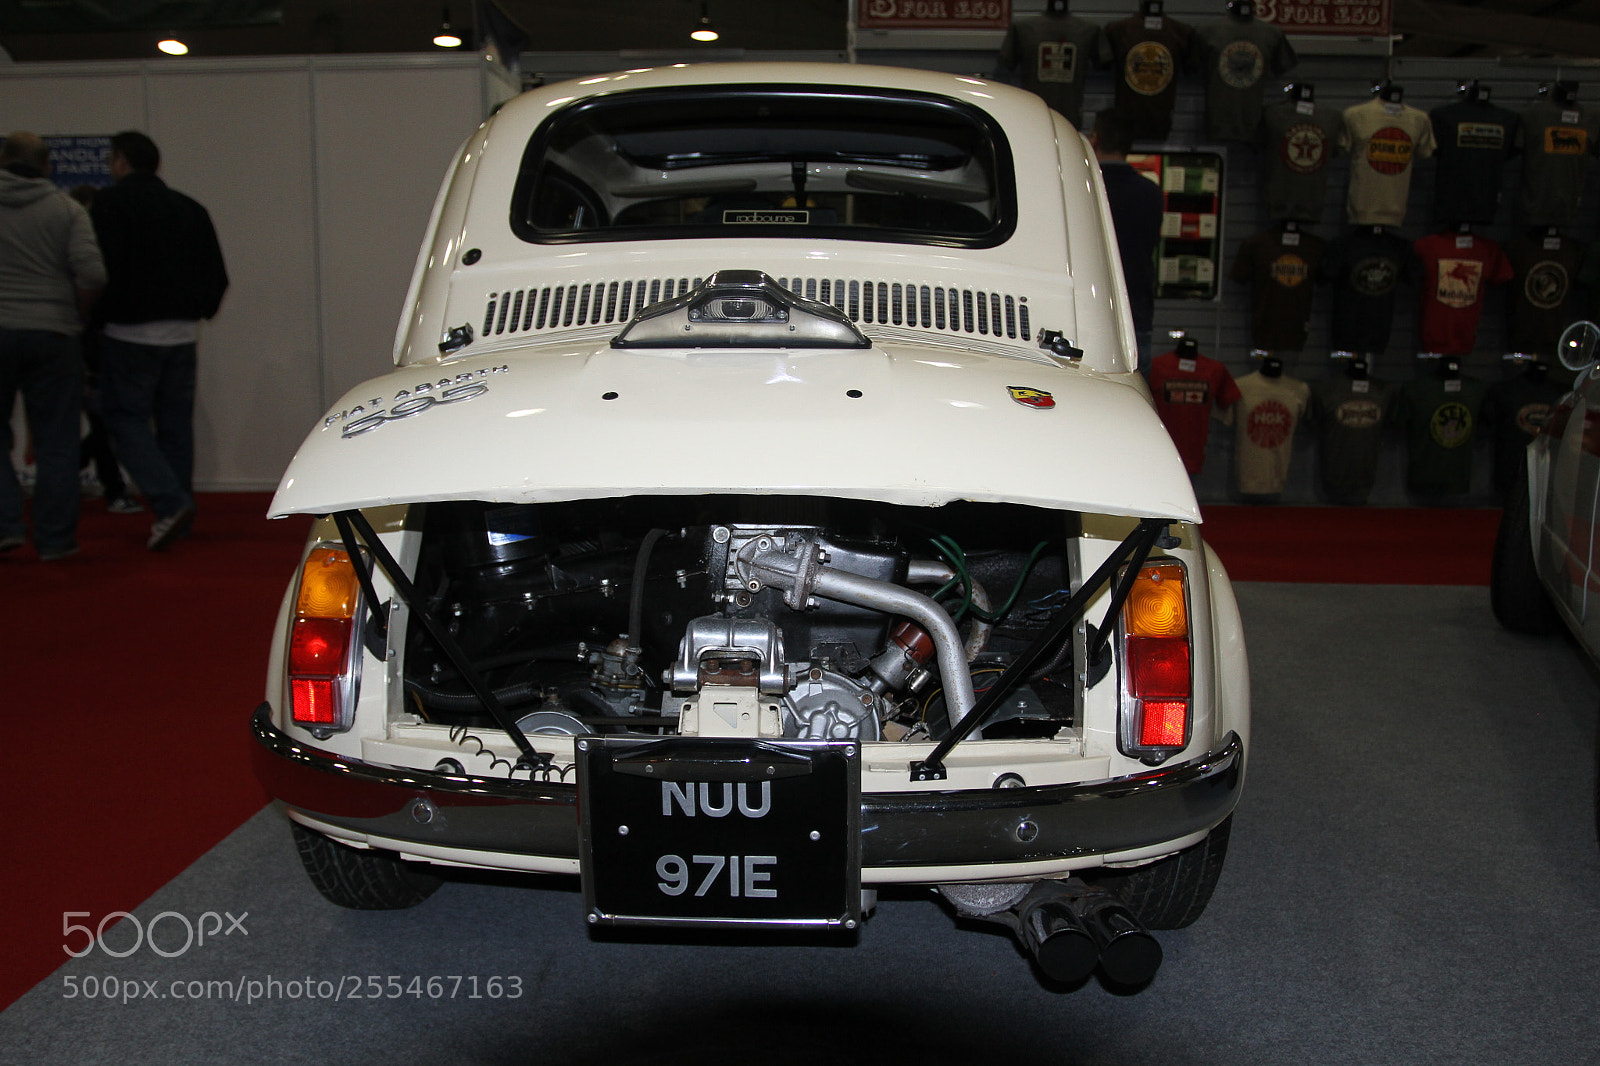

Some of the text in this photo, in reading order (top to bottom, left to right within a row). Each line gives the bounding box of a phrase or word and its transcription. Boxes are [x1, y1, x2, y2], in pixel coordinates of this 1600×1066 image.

[898, 1, 948, 18] FOR
[954, 1, 1001, 19] £50
[1278, 5, 1328, 23] FOR
[1332, 6, 1381, 24] £50
[736, 211, 796, 223] radbourne
[322, 365, 510, 430] FIAT ABARTH
[1254, 412, 1287, 425] NGK
[661, 781, 772, 818] NUU
[655, 854, 778, 898] 971E
